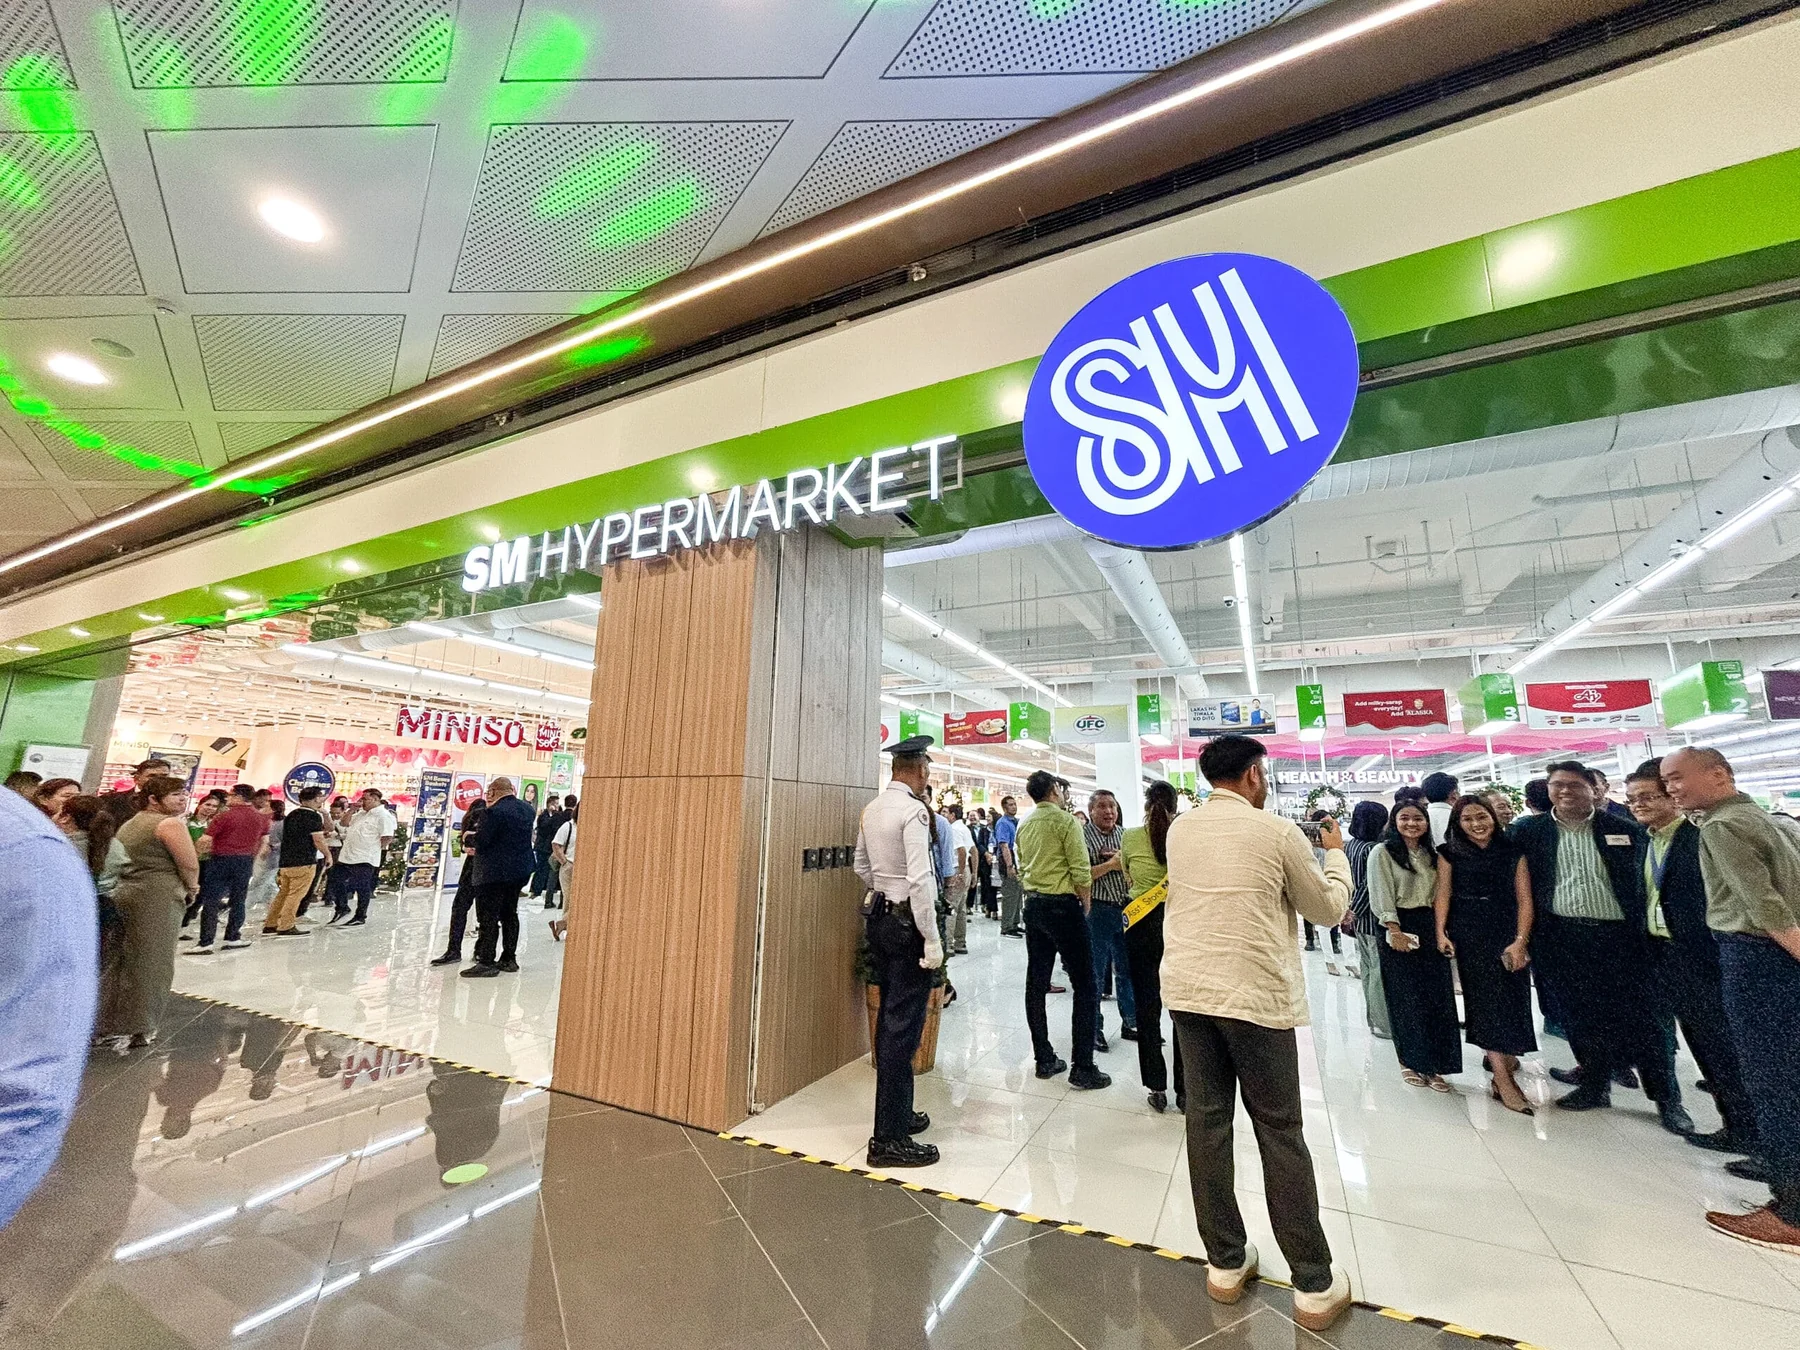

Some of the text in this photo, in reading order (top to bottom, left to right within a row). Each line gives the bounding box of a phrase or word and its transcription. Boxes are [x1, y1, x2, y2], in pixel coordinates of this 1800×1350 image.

[1050, 267, 1320, 516] SM
[462, 434, 958, 592] SM HYPERMARKET
[1731, 697, 1749, 713] 2
[1503, 706, 1518, 720] 3
[396, 706, 524, 748] MINISO
[1075, 718, 1105, 730] UFC
[1150, 721, 1160, 733] 5
[1313, 715, 1325, 728] 4
[1020, 728, 1029, 738] 6
[1278, 770, 1425, 784] HEALTH & BEAUTY
[456, 787, 481, 800] Free
[1128, 888, 1164, 919] Asst. Store
